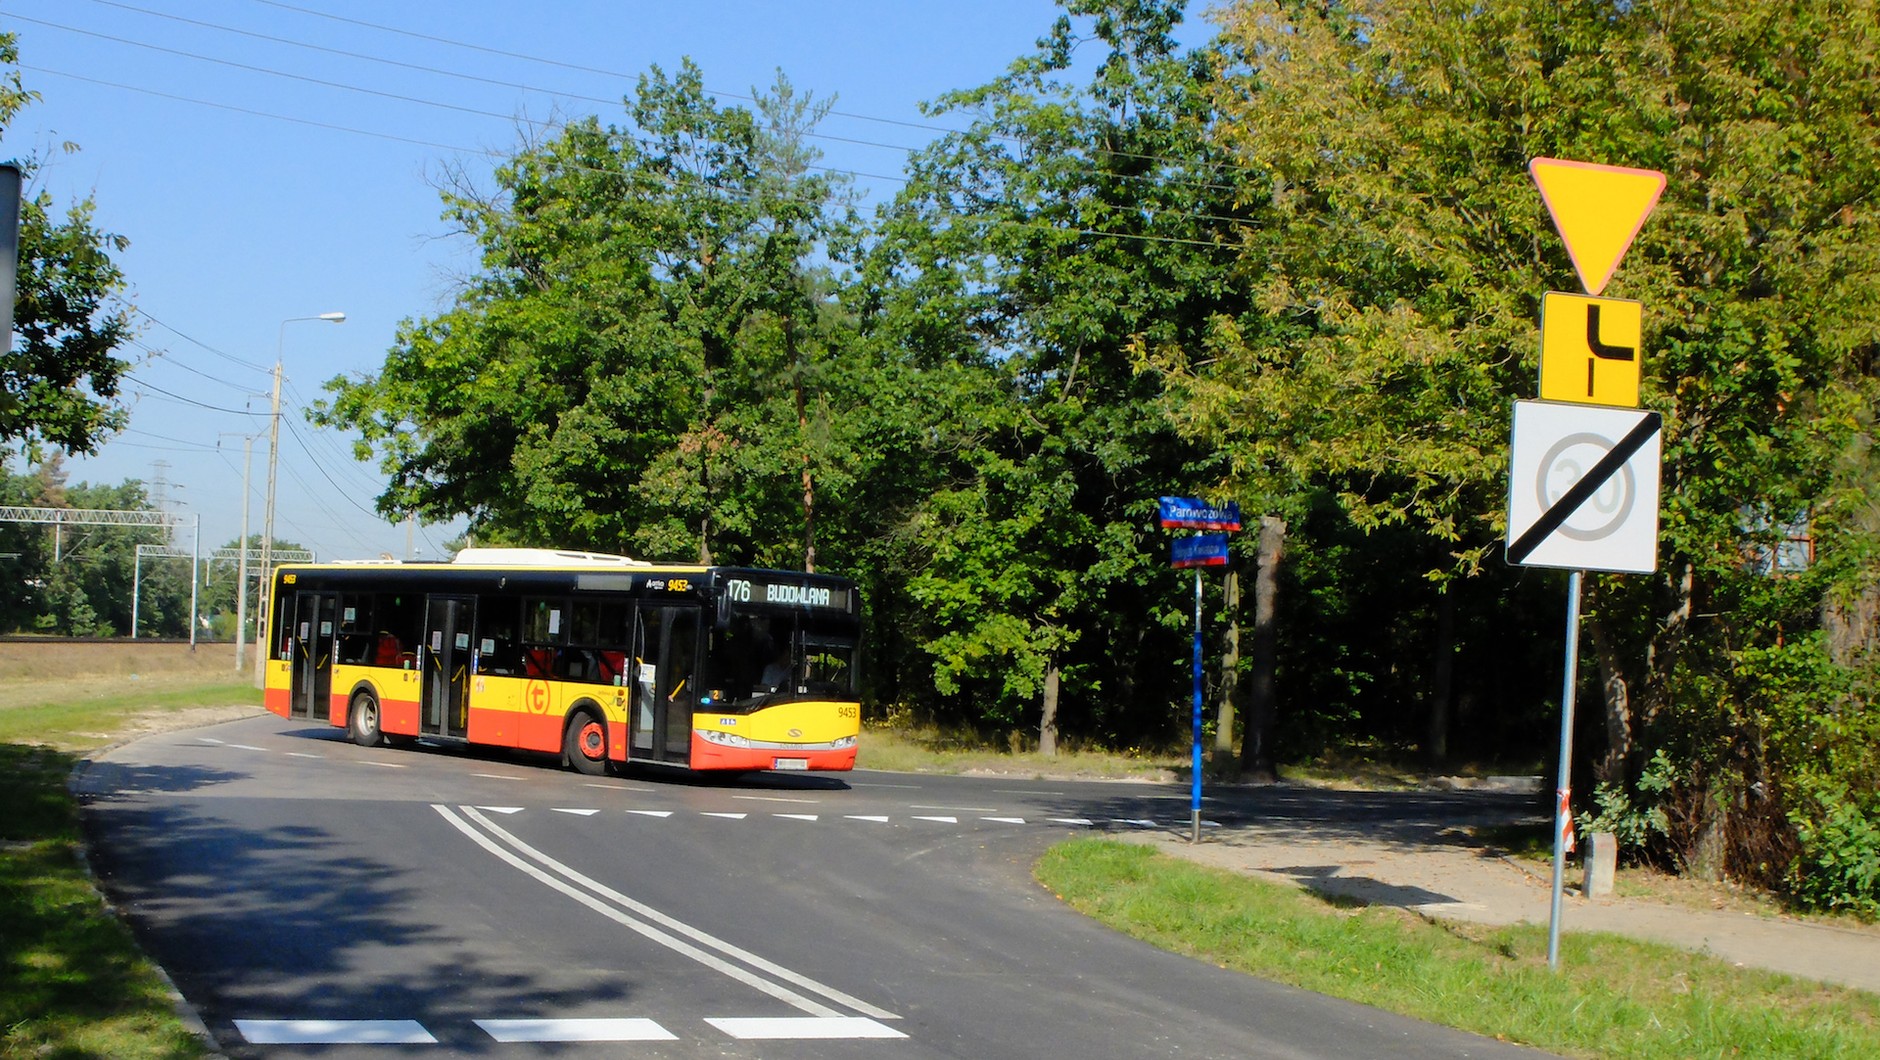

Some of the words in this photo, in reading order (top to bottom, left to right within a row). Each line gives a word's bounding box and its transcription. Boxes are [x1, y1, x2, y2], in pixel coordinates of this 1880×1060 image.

[1169, 505, 1233, 520] Parowozowa
[667, 579, 688, 592] 9453
[727, 579, 751, 602] 176
[767, 584, 830, 606] BUDOWLANA
[838, 706, 857, 719] 9453
